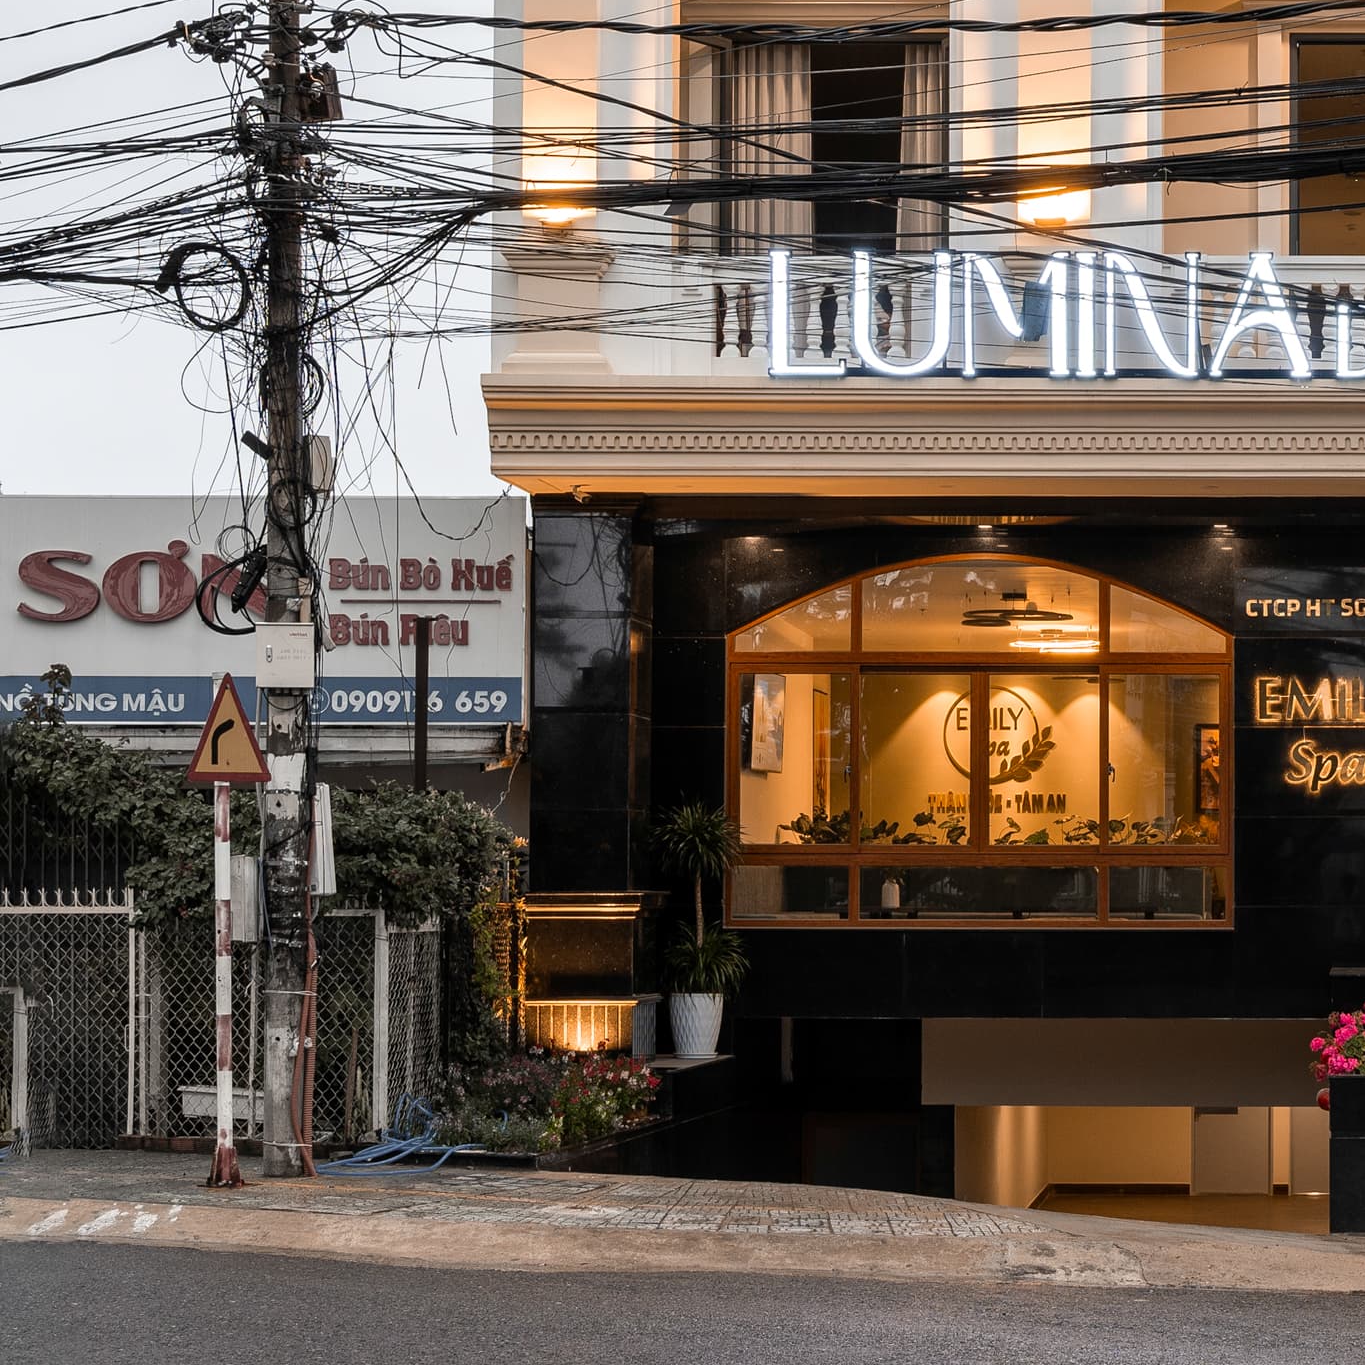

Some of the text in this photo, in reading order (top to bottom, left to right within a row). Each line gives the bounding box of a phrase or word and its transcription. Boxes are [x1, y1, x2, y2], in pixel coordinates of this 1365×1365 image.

[768, 249, 1313, 378] LUMINA
[328, 554, 515, 591] Bún Bò Huế
[1245, 598, 1300, 617] CTCP
[1306, 598, 1335, 617] HT
[328, 612, 390, 646] Bún
[43, 687, 118, 713] TÙNG
[122, 688, 185, 716] MẬU
[331, 689, 508, 714] 090916 659
[956, 707, 1024, 731] EILY
[1015, 790, 1044, 814] TÂM
[1046, 794, 1067, 814] AN
